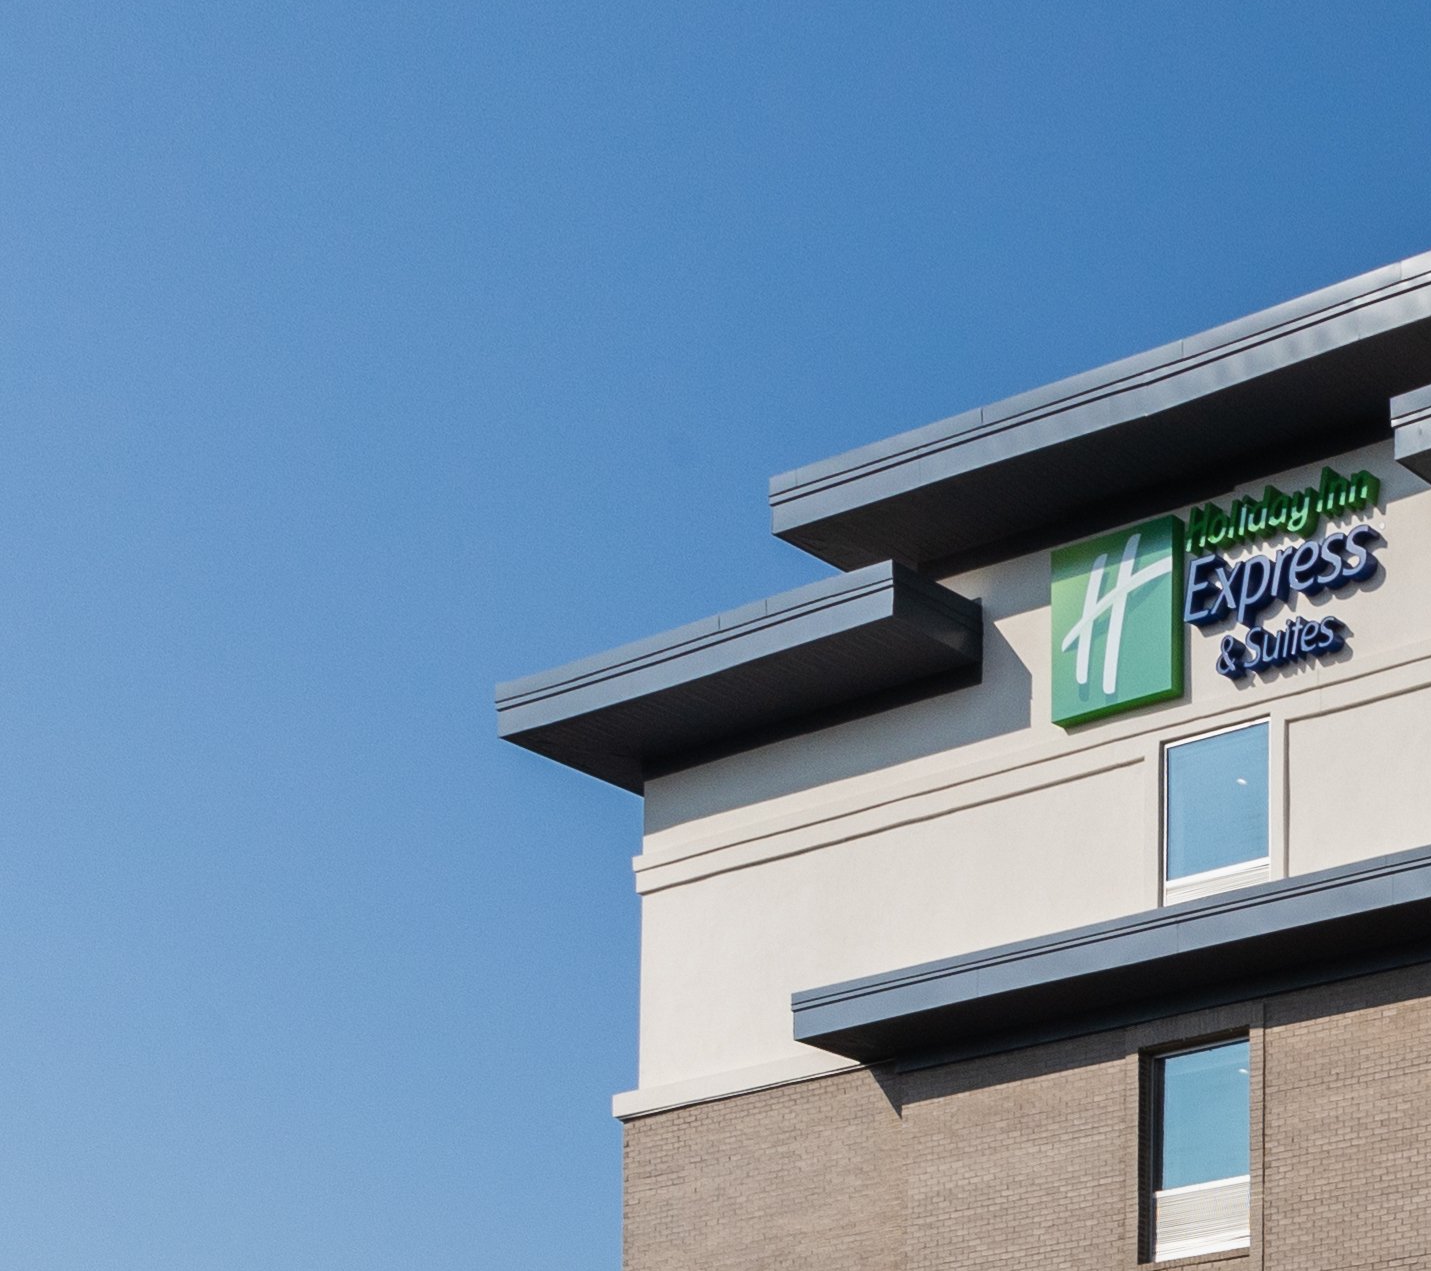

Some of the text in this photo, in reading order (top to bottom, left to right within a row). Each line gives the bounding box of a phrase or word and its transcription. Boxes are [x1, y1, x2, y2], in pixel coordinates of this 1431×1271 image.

[1186, 466, 1381, 554] Holiday Inn
[1184, 524, 1380, 626] Express
[1216, 616, 1342, 678] & Suites
